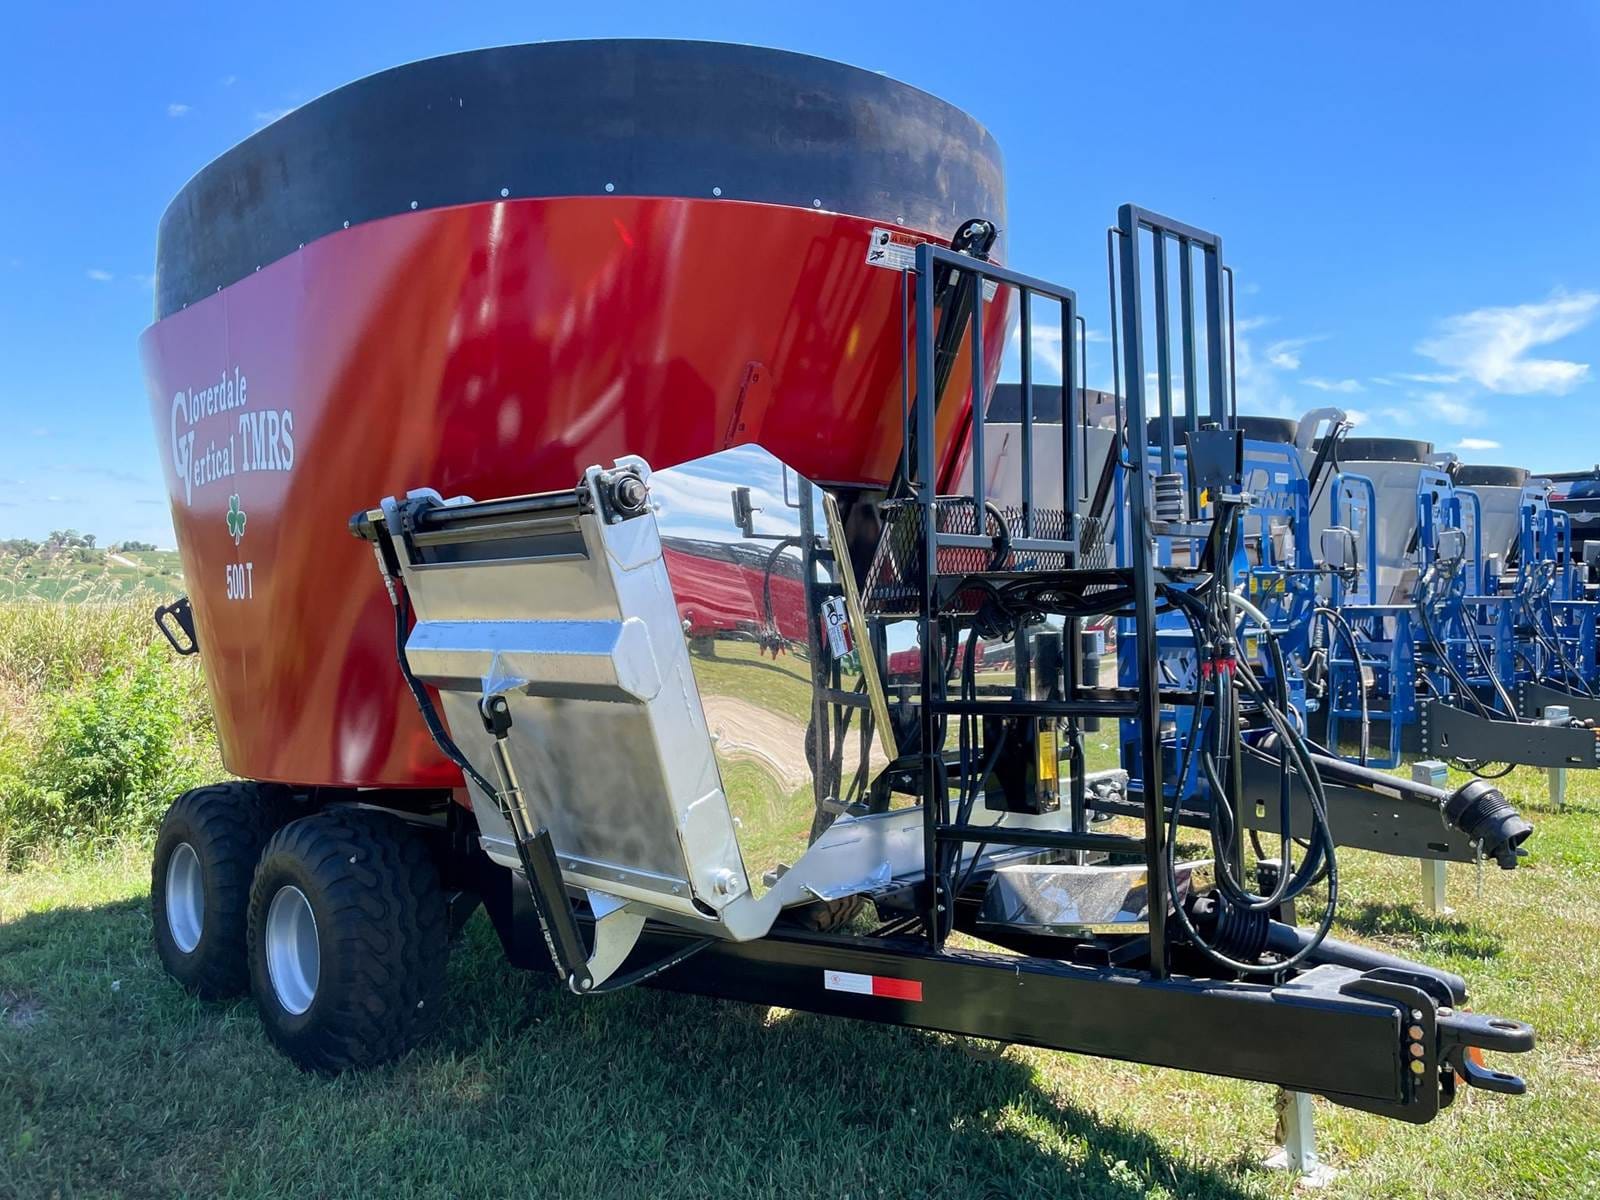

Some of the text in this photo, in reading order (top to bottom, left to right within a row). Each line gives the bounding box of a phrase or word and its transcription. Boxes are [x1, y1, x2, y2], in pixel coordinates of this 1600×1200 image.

[171, 366, 247, 479] Cloverdale
[178, 409, 294, 507] Vertical TMRS
[226, 562, 253, 600] 500 T
